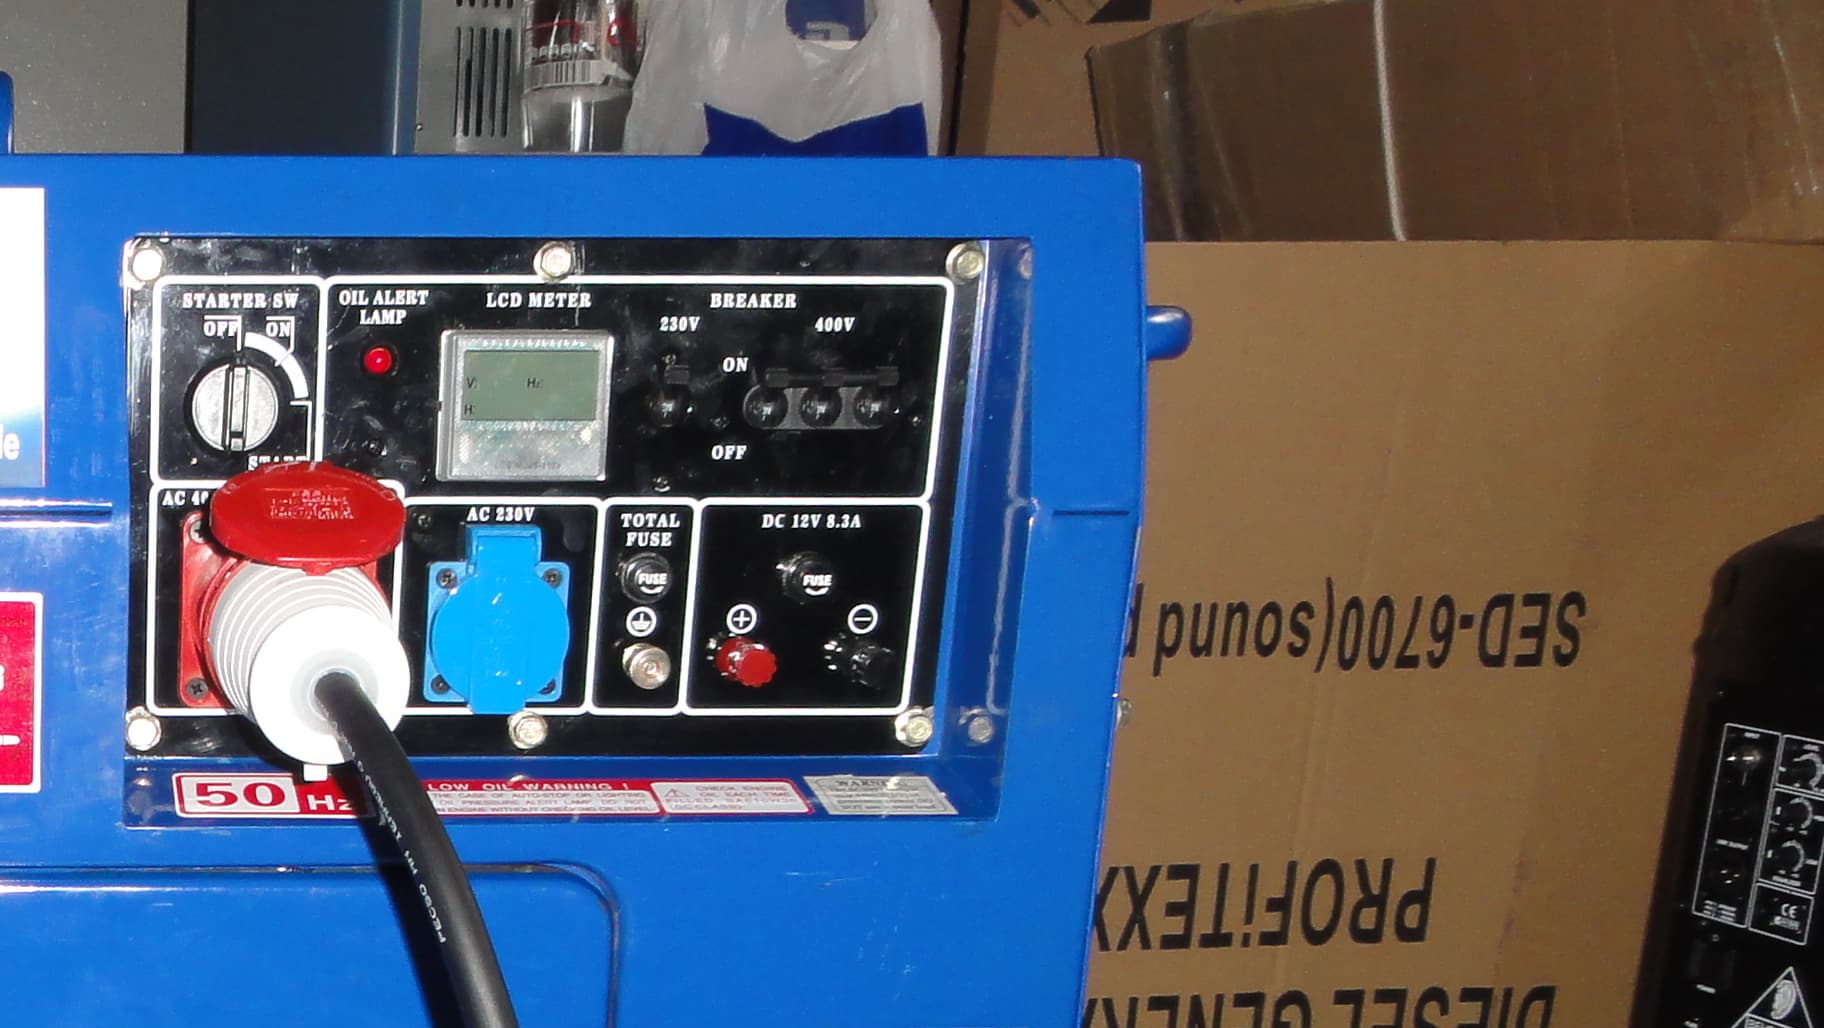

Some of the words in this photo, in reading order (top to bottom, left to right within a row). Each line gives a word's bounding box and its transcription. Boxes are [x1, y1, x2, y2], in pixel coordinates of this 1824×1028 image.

[182, 292, 267, 309] STARTER
[272, 292, 299, 309] SW
[339, 289, 370, 306] OIL
[375, 289, 429, 306] ALERT
[486, 292, 522, 308] LCD
[528, 292, 592, 309] METER
[709, 292, 797, 309] BREAKER
[359, 309, 407, 325] LAMP
[659, 316, 701, 333] 230V
[814, 316, 856, 333] 400V
[203, 321, 238, 337] OFF
[265, 321, 291, 337] ON
[722, 357, 749, 373] ON
[711, 445, 748, 461] OFF
[162, 491, 187, 507] AC
[466, 507, 490, 522] AC
[495, 506, 535, 522] 230V
[620, 513, 681, 529] TOTAL
[761, 513, 784, 529] DC
[790, 513, 821, 529] 12V
[825, 513, 862, 529] 8.3A
[625, 531, 673, 547] FUSE
[637, 573, 667, 585] FUSE
[803, 575, 833, 587] FUSE
[1152, 577, 1588, 678] SED-6700(sound
[428, 783, 470, 791] LOW
[482, 783, 509, 791] OIL
[522, 783, 612, 791] WARNING
[195, 782, 287, 808] 50
[307, 794, 354, 811] Hz
